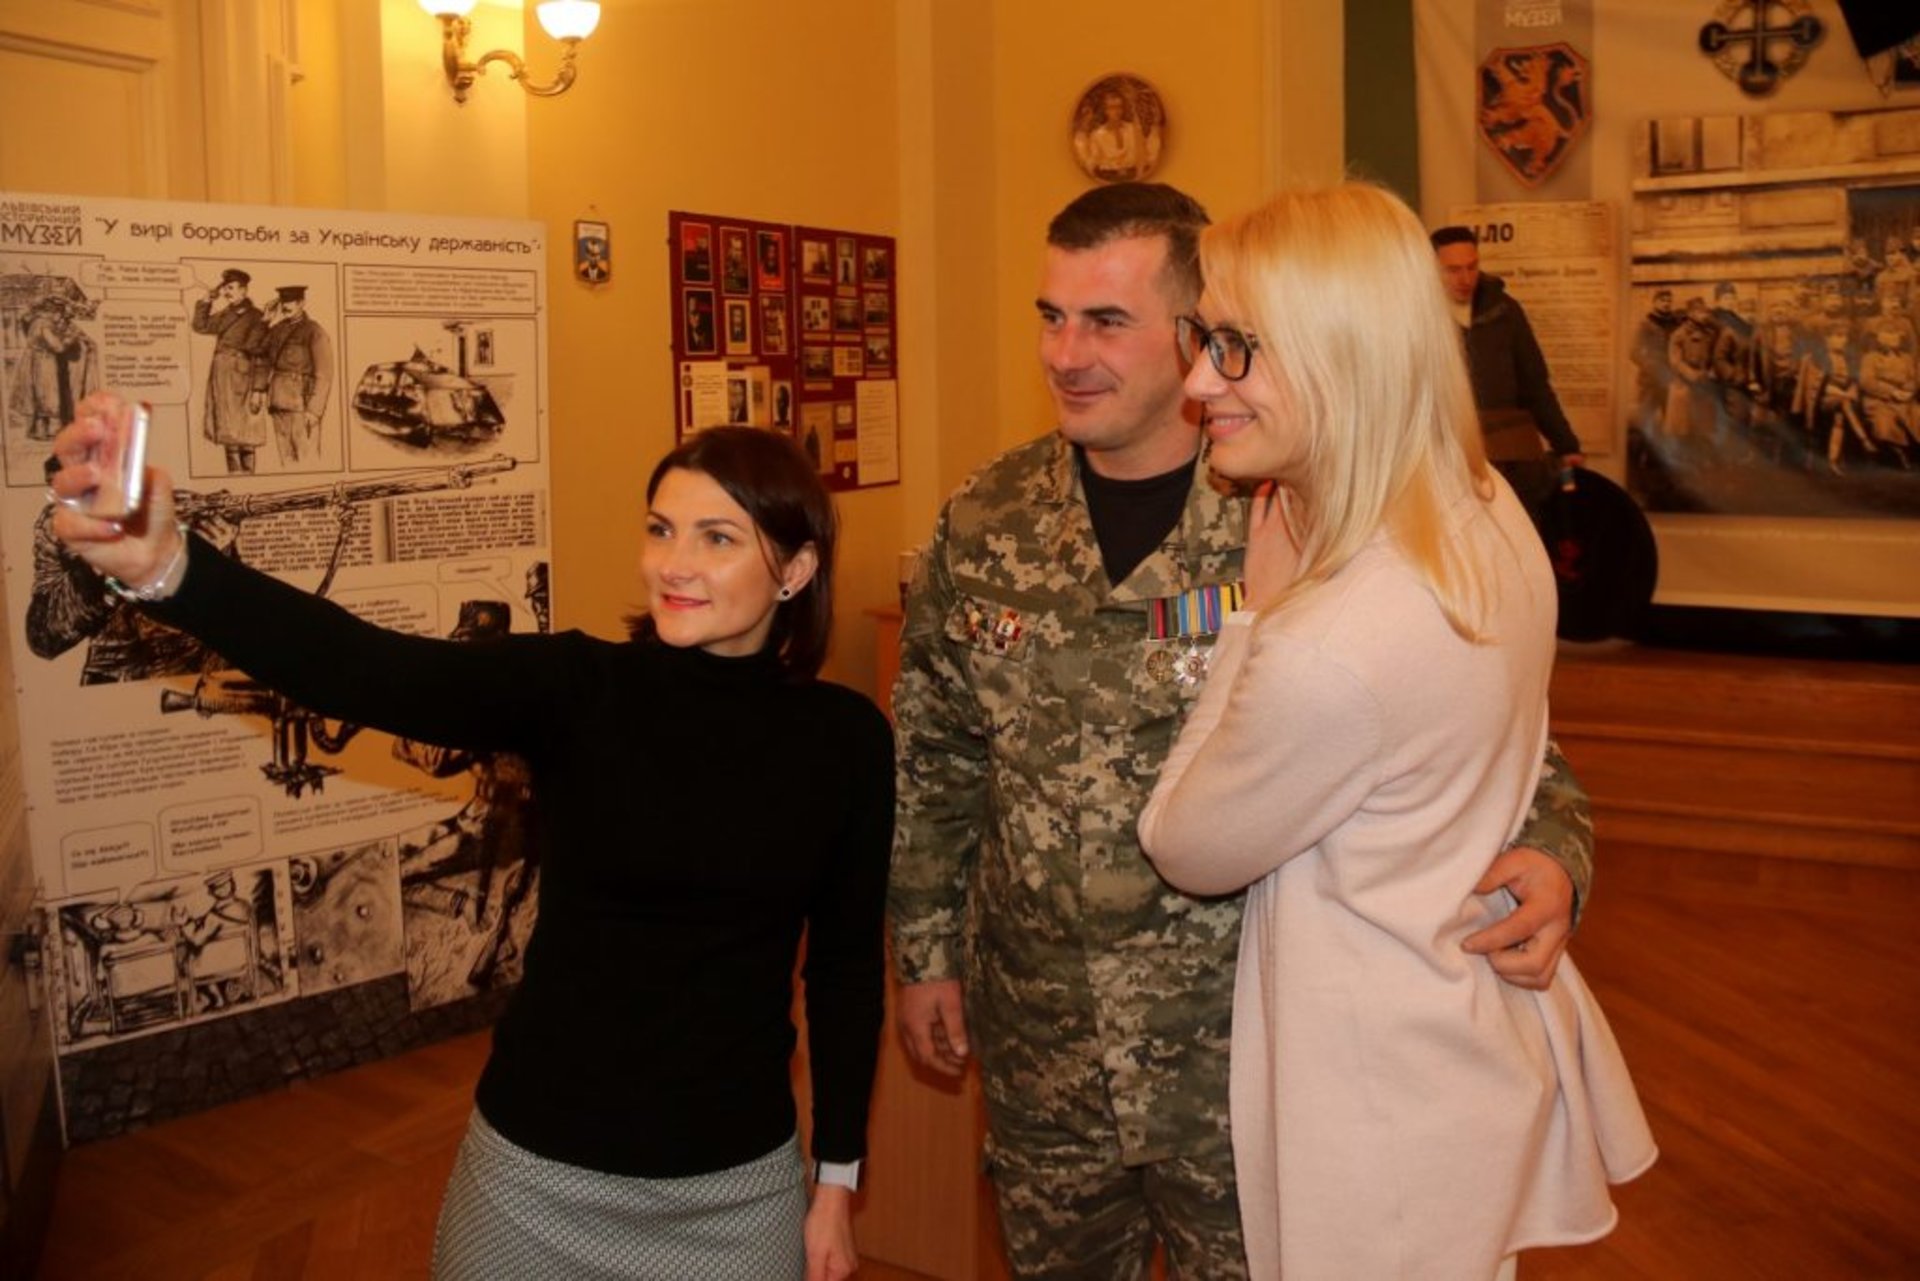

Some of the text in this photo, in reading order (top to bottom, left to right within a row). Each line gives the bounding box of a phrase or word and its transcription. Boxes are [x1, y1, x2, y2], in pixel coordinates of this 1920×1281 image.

[1, 222, 82, 246] МУЗЕЙ
[130, 222, 173, 243] вирі
[182, 222, 280, 245] боротьби
[290, 230, 310, 244] за
[319, 228, 421, 253] Українську
